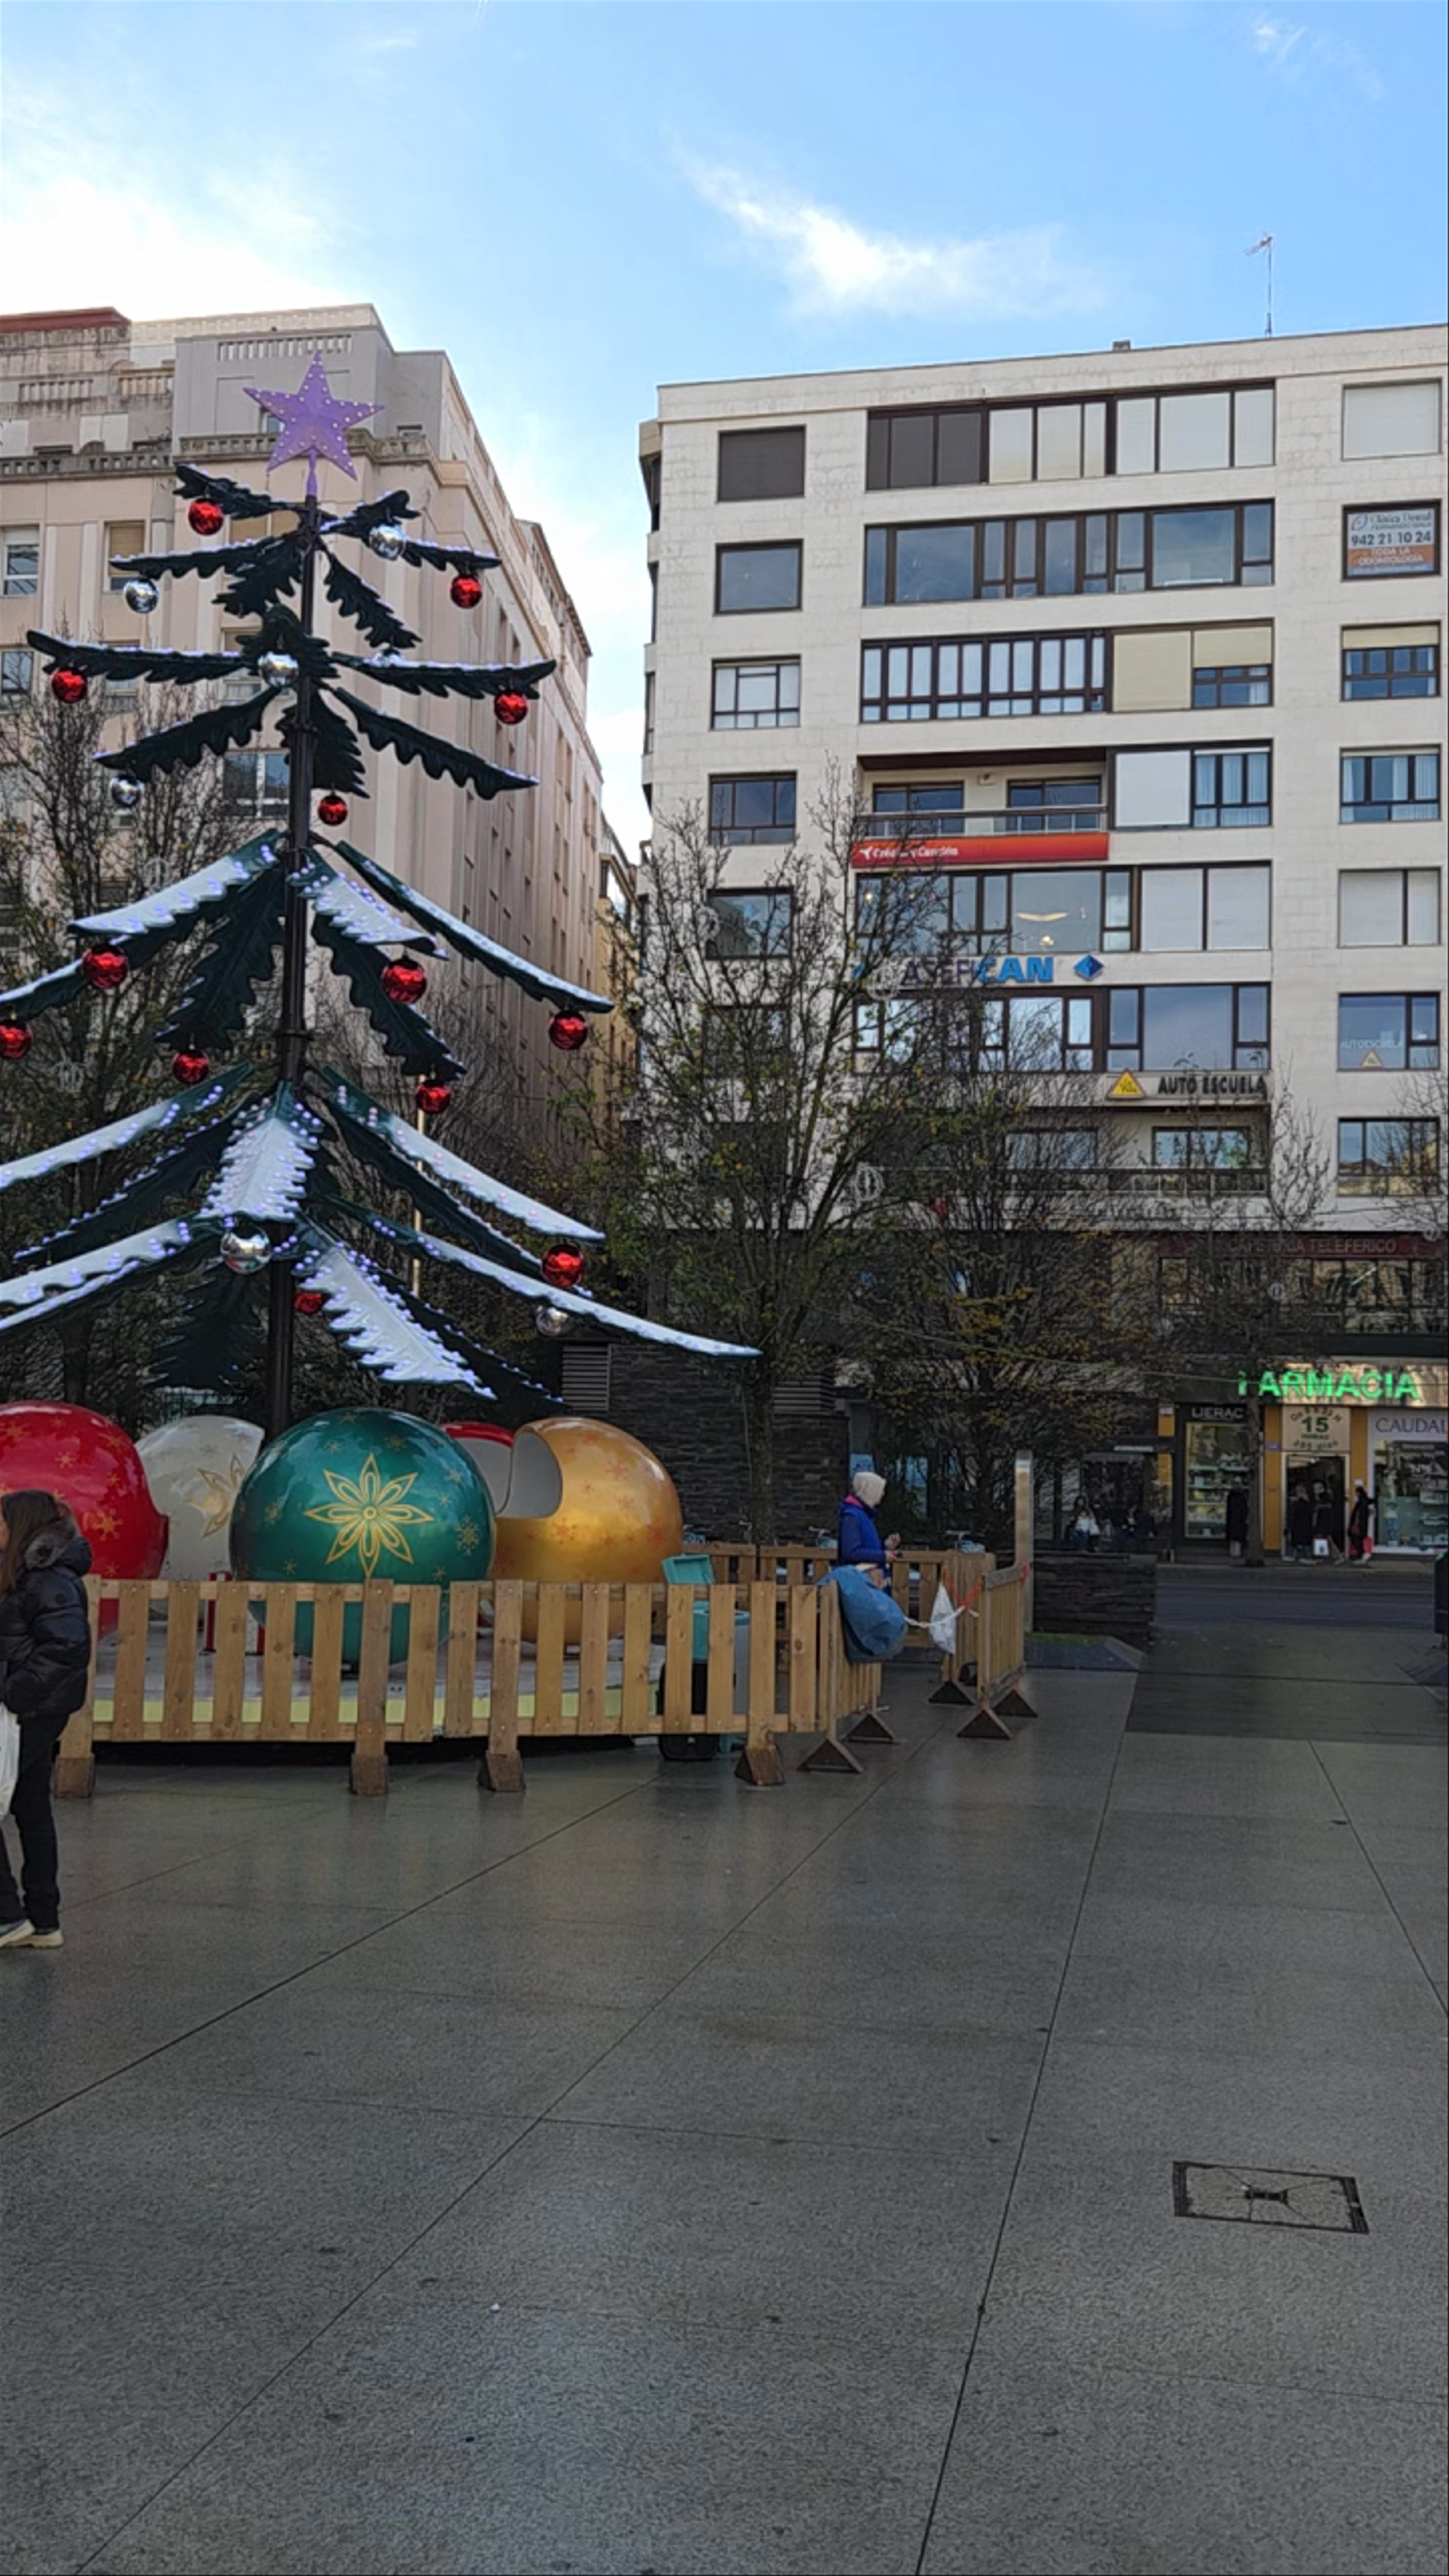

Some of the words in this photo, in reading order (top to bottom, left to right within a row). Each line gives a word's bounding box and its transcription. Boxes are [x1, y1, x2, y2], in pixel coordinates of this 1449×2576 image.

[1403, 511, 1431, 521] Dental
[1351, 534, 1375, 546] 942
[1377, 532, 1392, 545] 21
[1398, 532, 1412, 543] 10
[1415, 531, 1431, 543] 24
[1158, 1075, 1197, 1094] AUTO
[1203, 1074, 1267, 1094] ESCUELA
[1308, 1238, 1396, 1253] TELEFERICO
[1192, 1407, 1244, 1419] LIERAC
[1301, 1416, 1329, 1433] 15
